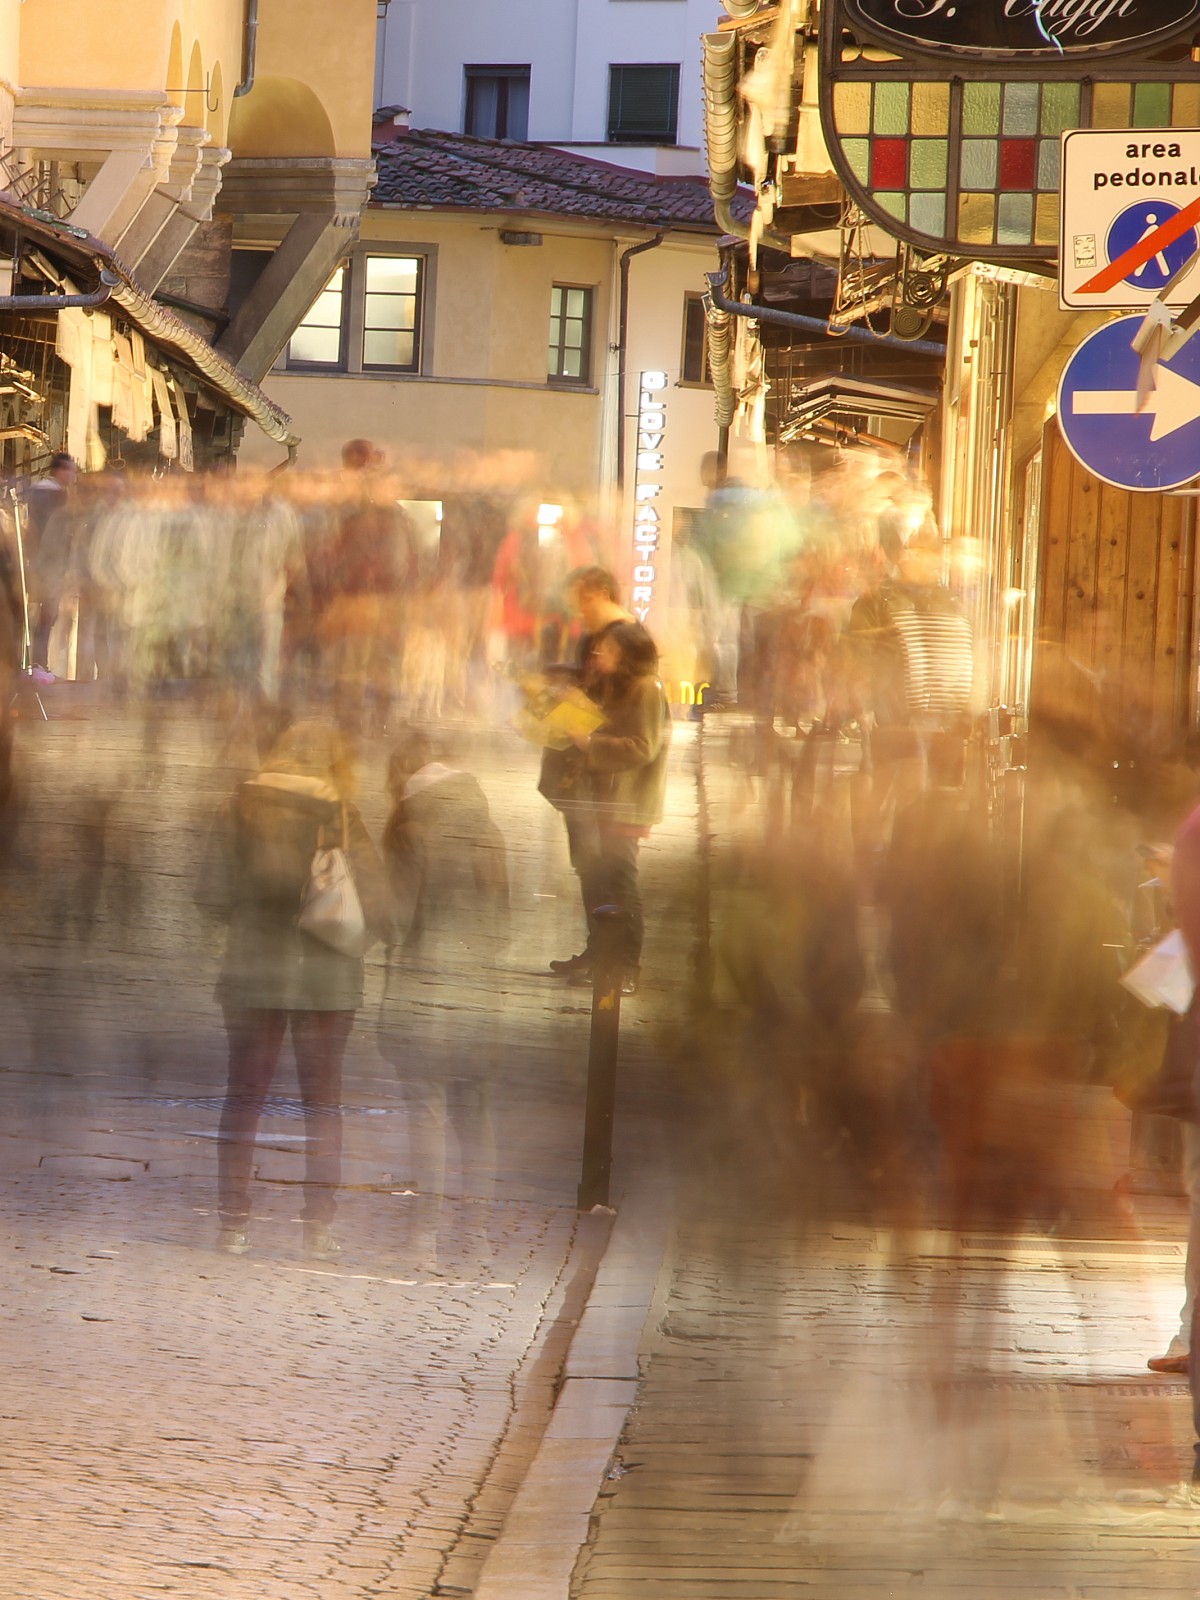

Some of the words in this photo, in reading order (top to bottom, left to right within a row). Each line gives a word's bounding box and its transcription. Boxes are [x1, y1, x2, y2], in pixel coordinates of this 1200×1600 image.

[1094, 167, 1200, 190] pedonal
[1126, 143, 1181, 158] area
[636, 371, 667, 470] GLOVE
[633, 484, 662, 622] FACTORY
